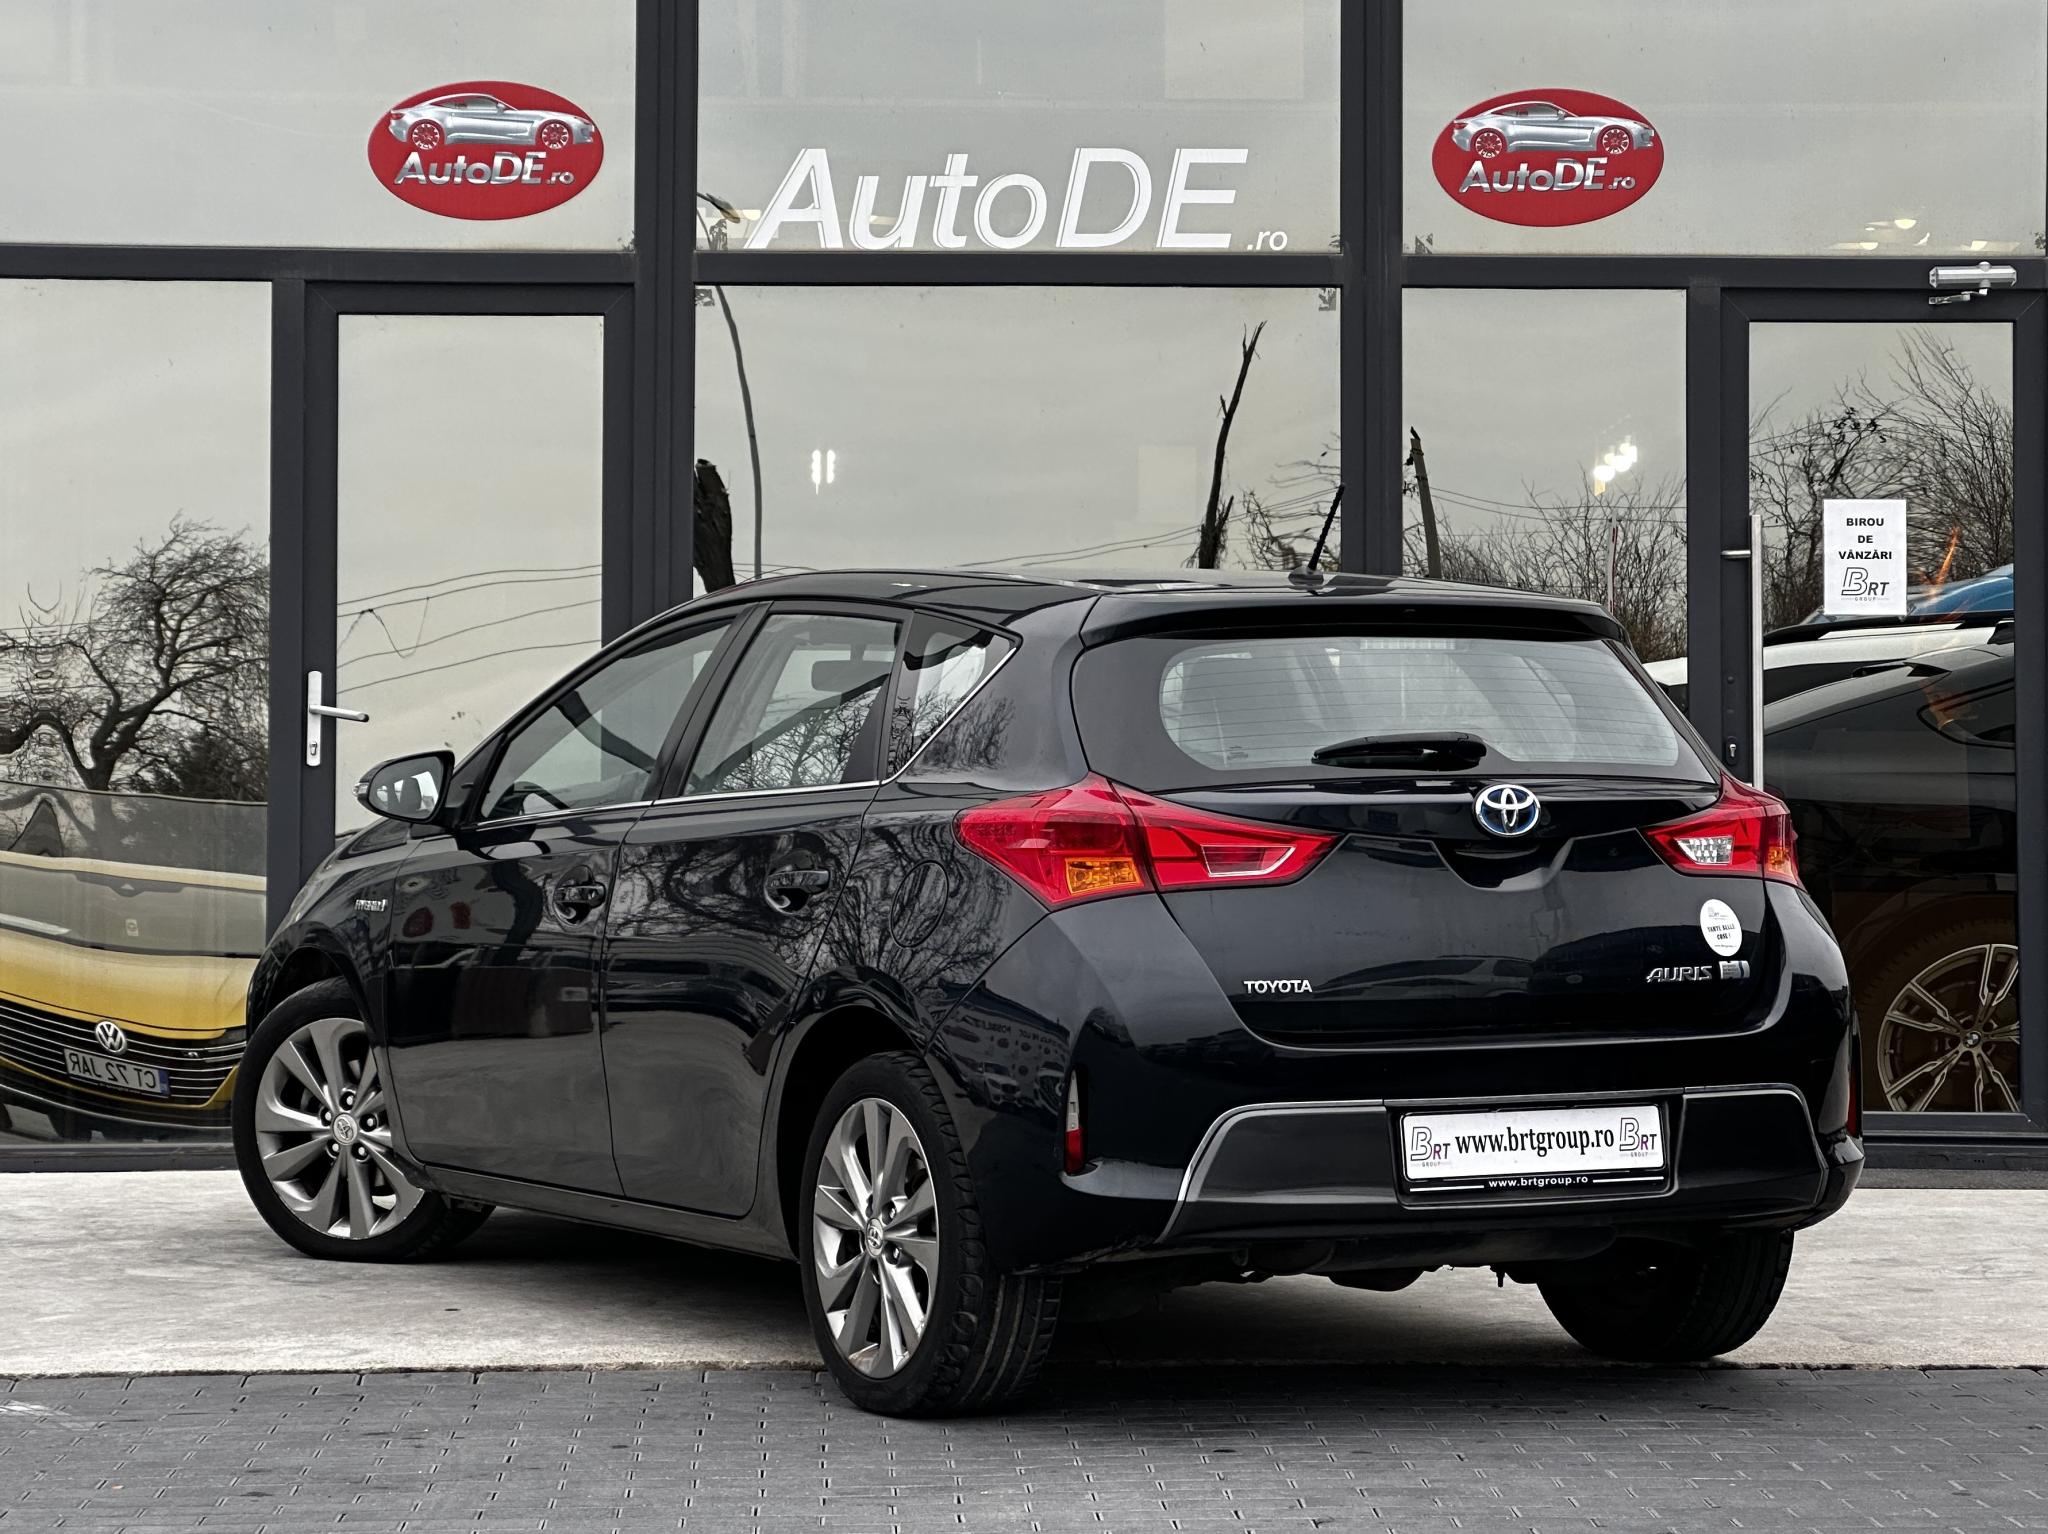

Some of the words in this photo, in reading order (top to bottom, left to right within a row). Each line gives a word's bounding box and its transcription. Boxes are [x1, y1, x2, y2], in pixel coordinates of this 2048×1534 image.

[1846, 518, 1884, 526] BIROU
[1857, 535, 1873, 544] DE
[1841, 567, 1890, 596] BRT
[1646, 965, 1713, 983] AURIS
[1243, 979, 1313, 994] TOYOTA
[1455, 1126, 1615, 1157] www.brtgroup.ro
[1619, 1117, 1657, 1151] BRT
[1410, 1126, 1451, 1161] BRT
[1488, 1176, 1589, 1188] www.brtgroup.ro
